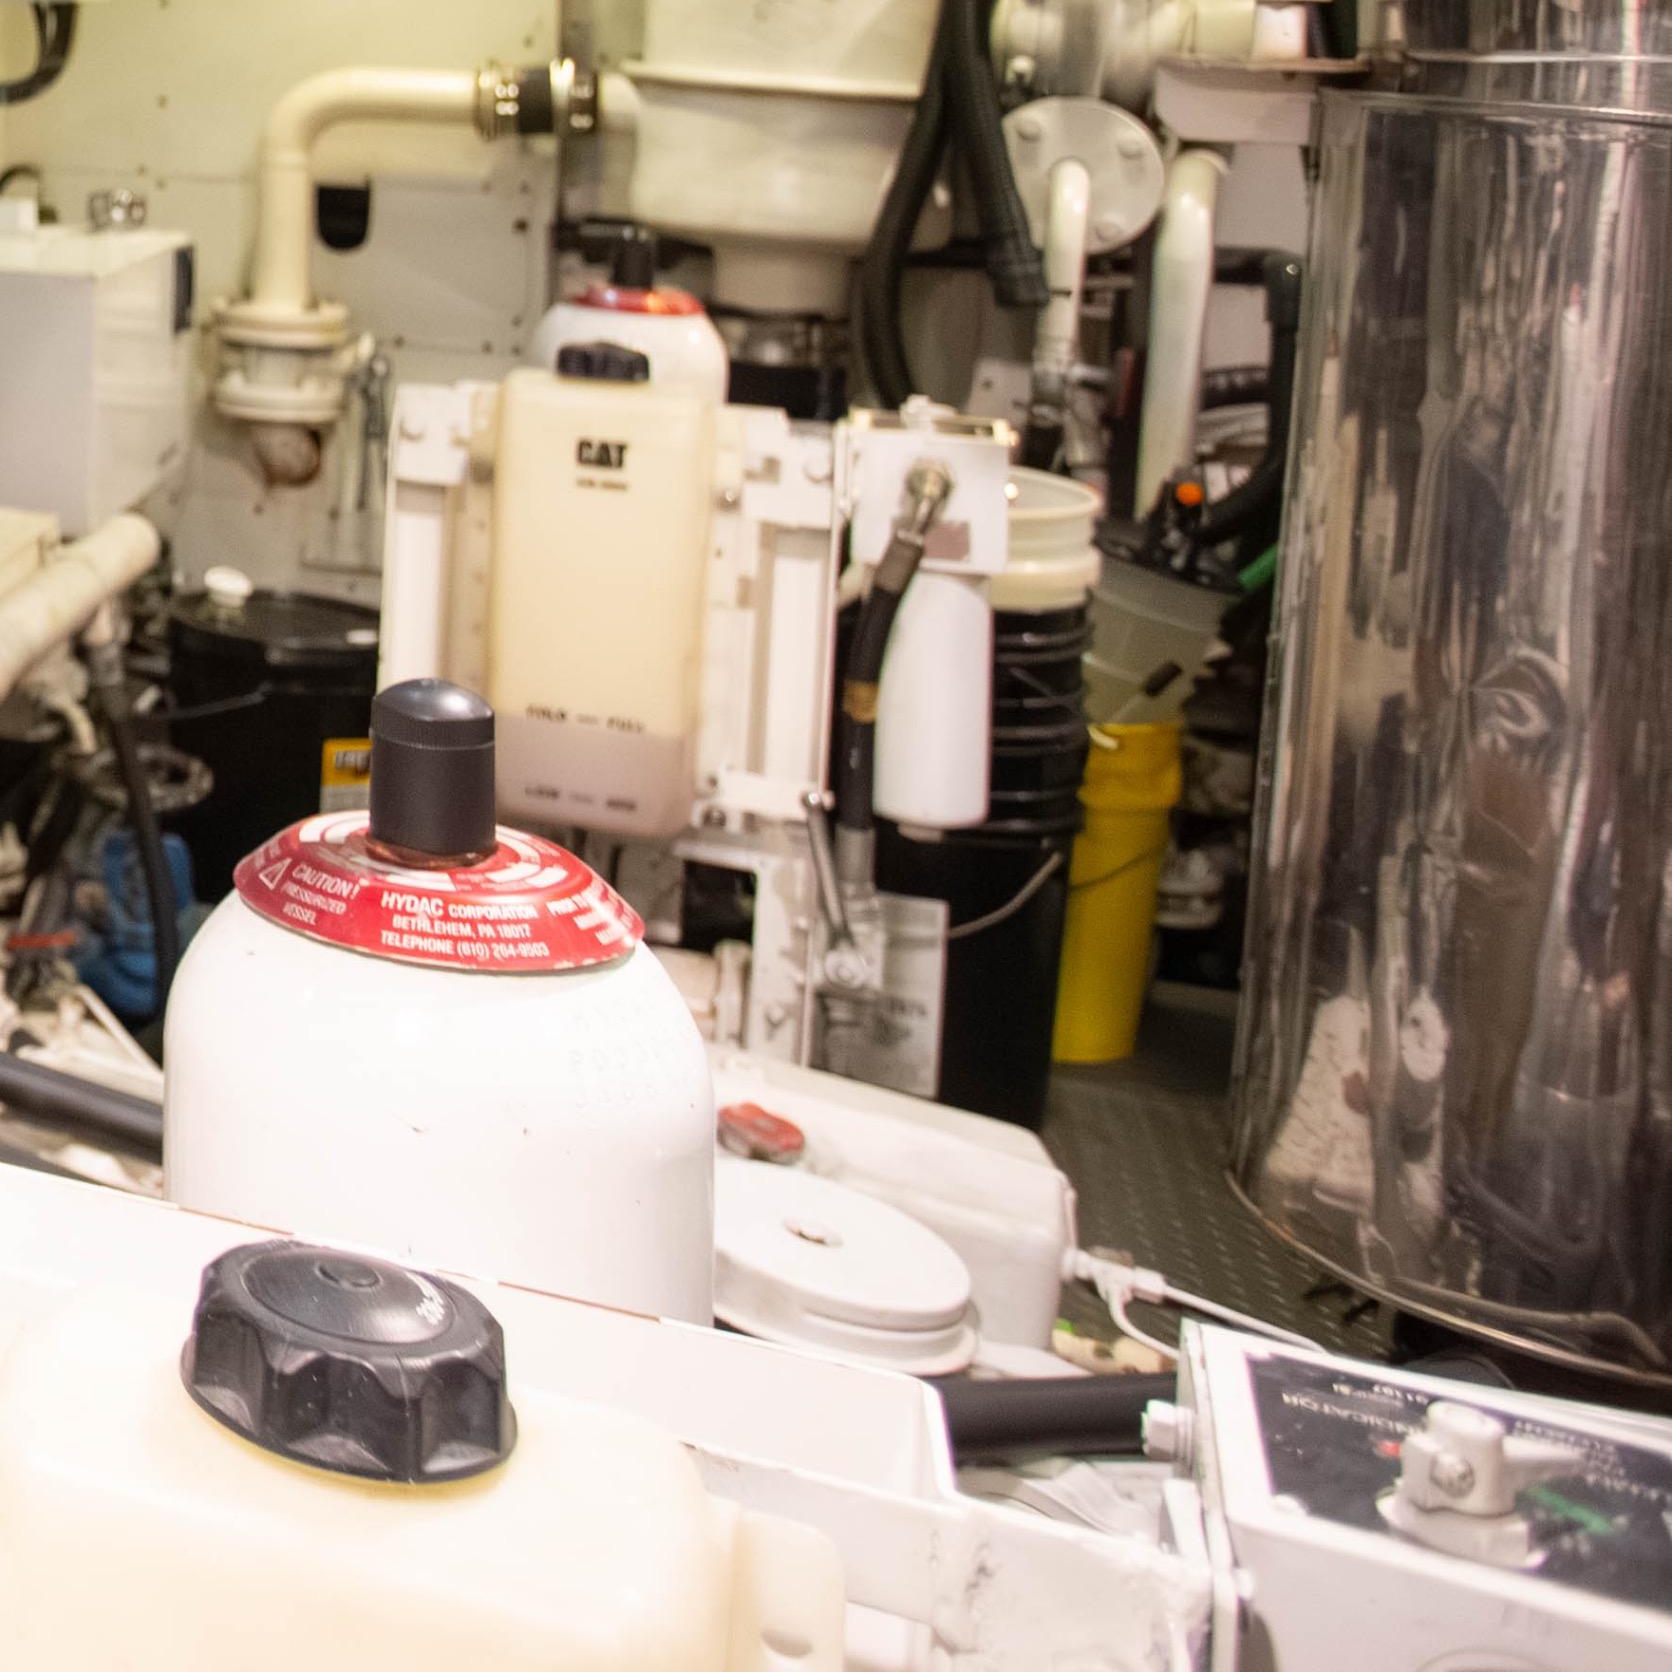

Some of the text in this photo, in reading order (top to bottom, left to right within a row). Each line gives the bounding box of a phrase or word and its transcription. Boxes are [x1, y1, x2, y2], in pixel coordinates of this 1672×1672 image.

[578, 439, 627, 469] CAT
[381, 890, 538, 921] HYDAC CORPORATION
[392, 913, 476, 939] BETHLEHEM,
[478, 922, 496, 938] PA
[381, 929, 454, 956] TELEPHONE
